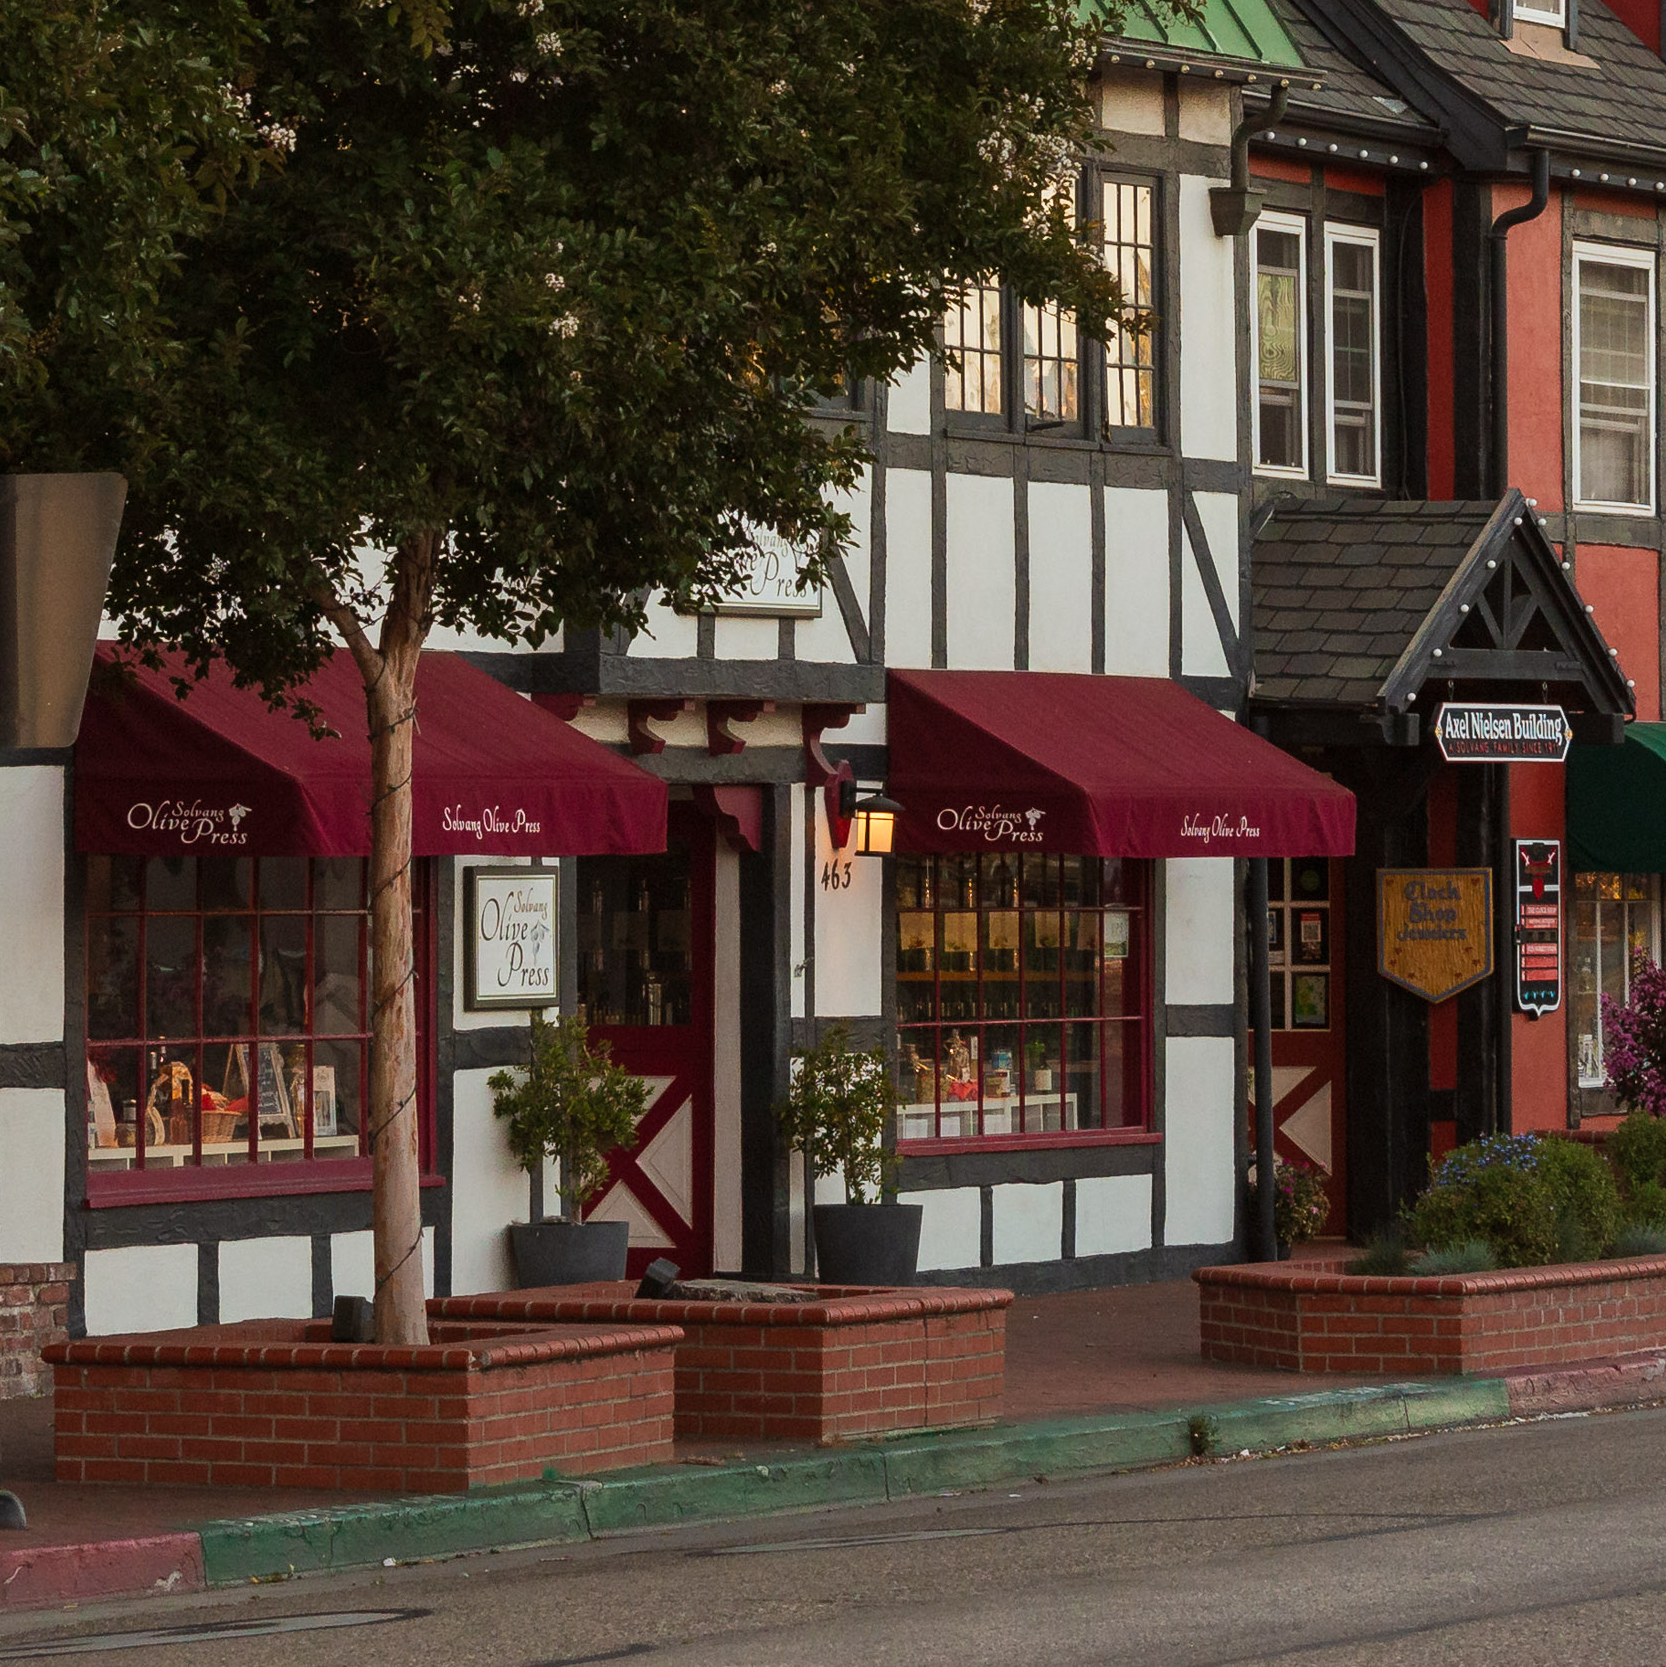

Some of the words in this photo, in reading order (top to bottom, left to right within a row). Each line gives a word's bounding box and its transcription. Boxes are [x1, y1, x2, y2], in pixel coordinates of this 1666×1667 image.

[1445, 712, 1470, 739] Axel
[1471, 712, 1513, 740] Nielsen
[1513, 713, 1562, 746] Building
[1456, 742, 1489, 754] SOLVANG
[1493, 742, 1519, 754] FAMILY
[1522, 742, 1542, 754] SINCE
[127, 800, 190, 830] Olive
[171, 799, 224, 823] Solvang
[442, 804, 483, 840] Solvang
[483, 805, 510, 833] Olive
[511, 808, 541, 833] Press
[936, 805, 992, 831] Olive
[974, 804, 1022, 823] Solvang
[180, 818, 248, 844] Press
[983, 819, 1044, 843] Press
[1180, 813, 1211, 844] Solvang
[1211, 813, 1234, 837] Olive
[1235, 815, 1260, 838] Press
[821, 858, 852, 892] 463
[514, 887, 548, 921] Solvang
[1404, 880, 1462, 902] Clock
[481, 891, 528, 941] Olive
[1409, 902, 1457, 924] Shop
[1397, 921, 1467, 942] Jewelers
[497, 939, 550, 987] Press
